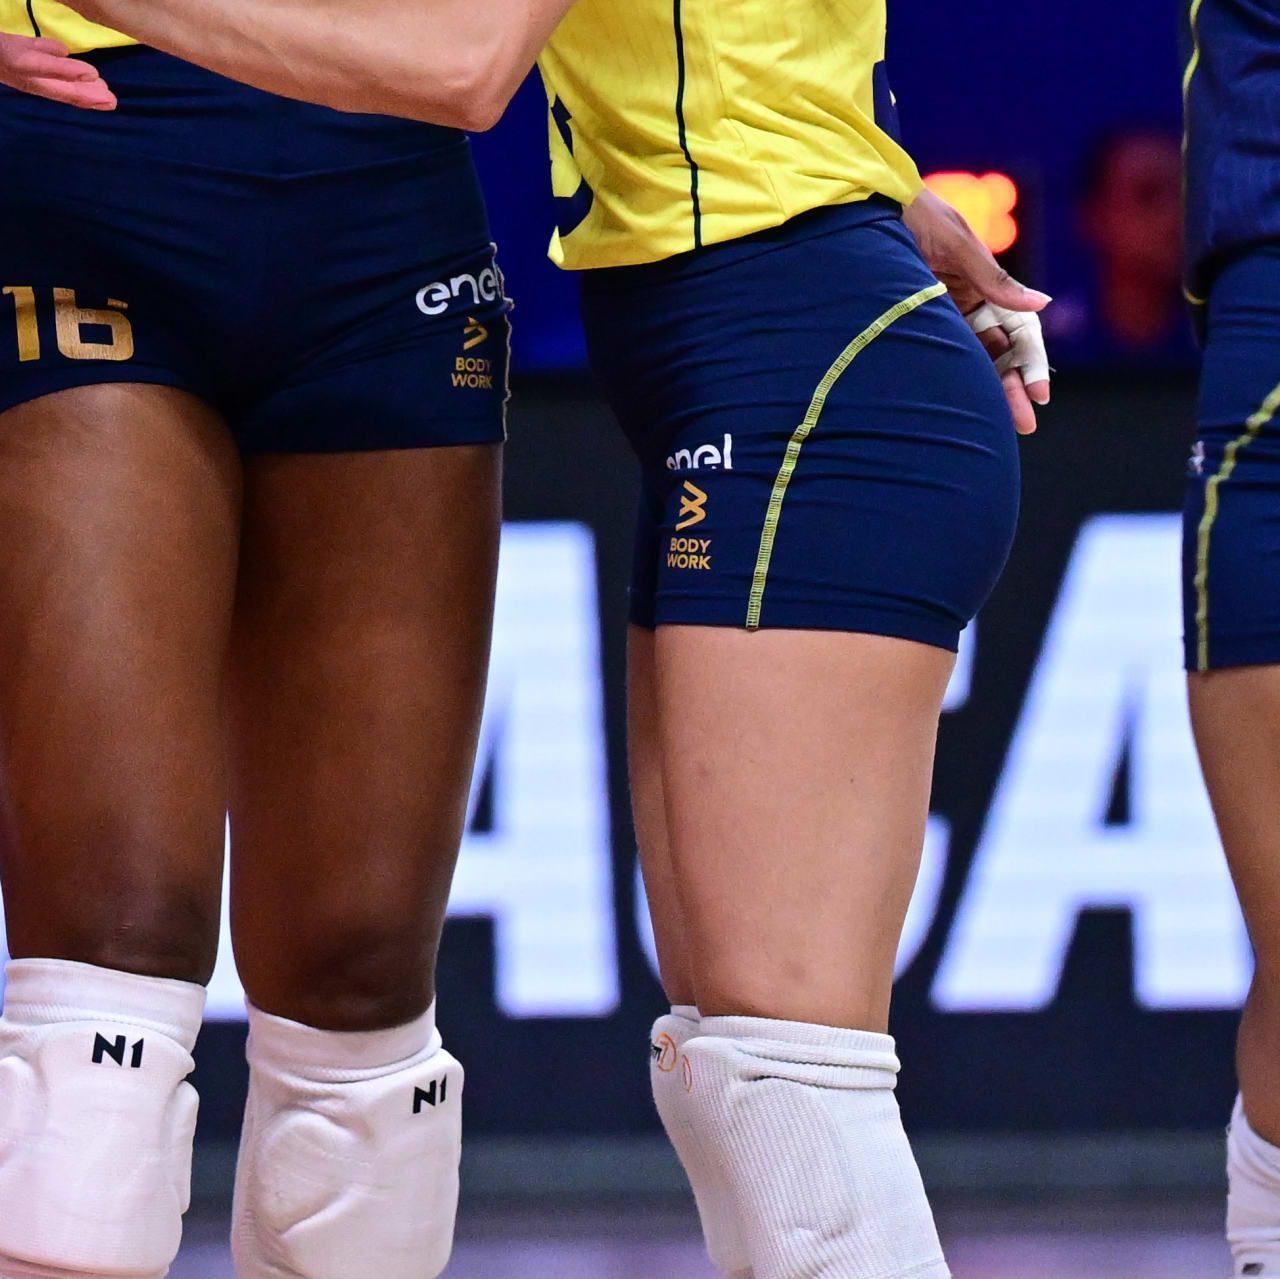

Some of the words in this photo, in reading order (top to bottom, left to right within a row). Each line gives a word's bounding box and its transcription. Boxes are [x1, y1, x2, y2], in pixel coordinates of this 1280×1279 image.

[2, 286, 134, 361] 16
[455, 357, 491, 372] BODY
[451, 373, 493, 389] WORK
[670, 538, 712, 553] BODY
[667, 553, 712, 569] WORK
[92, 1031, 145, 1068] N1
[412, 1073, 448, 1114] N1
